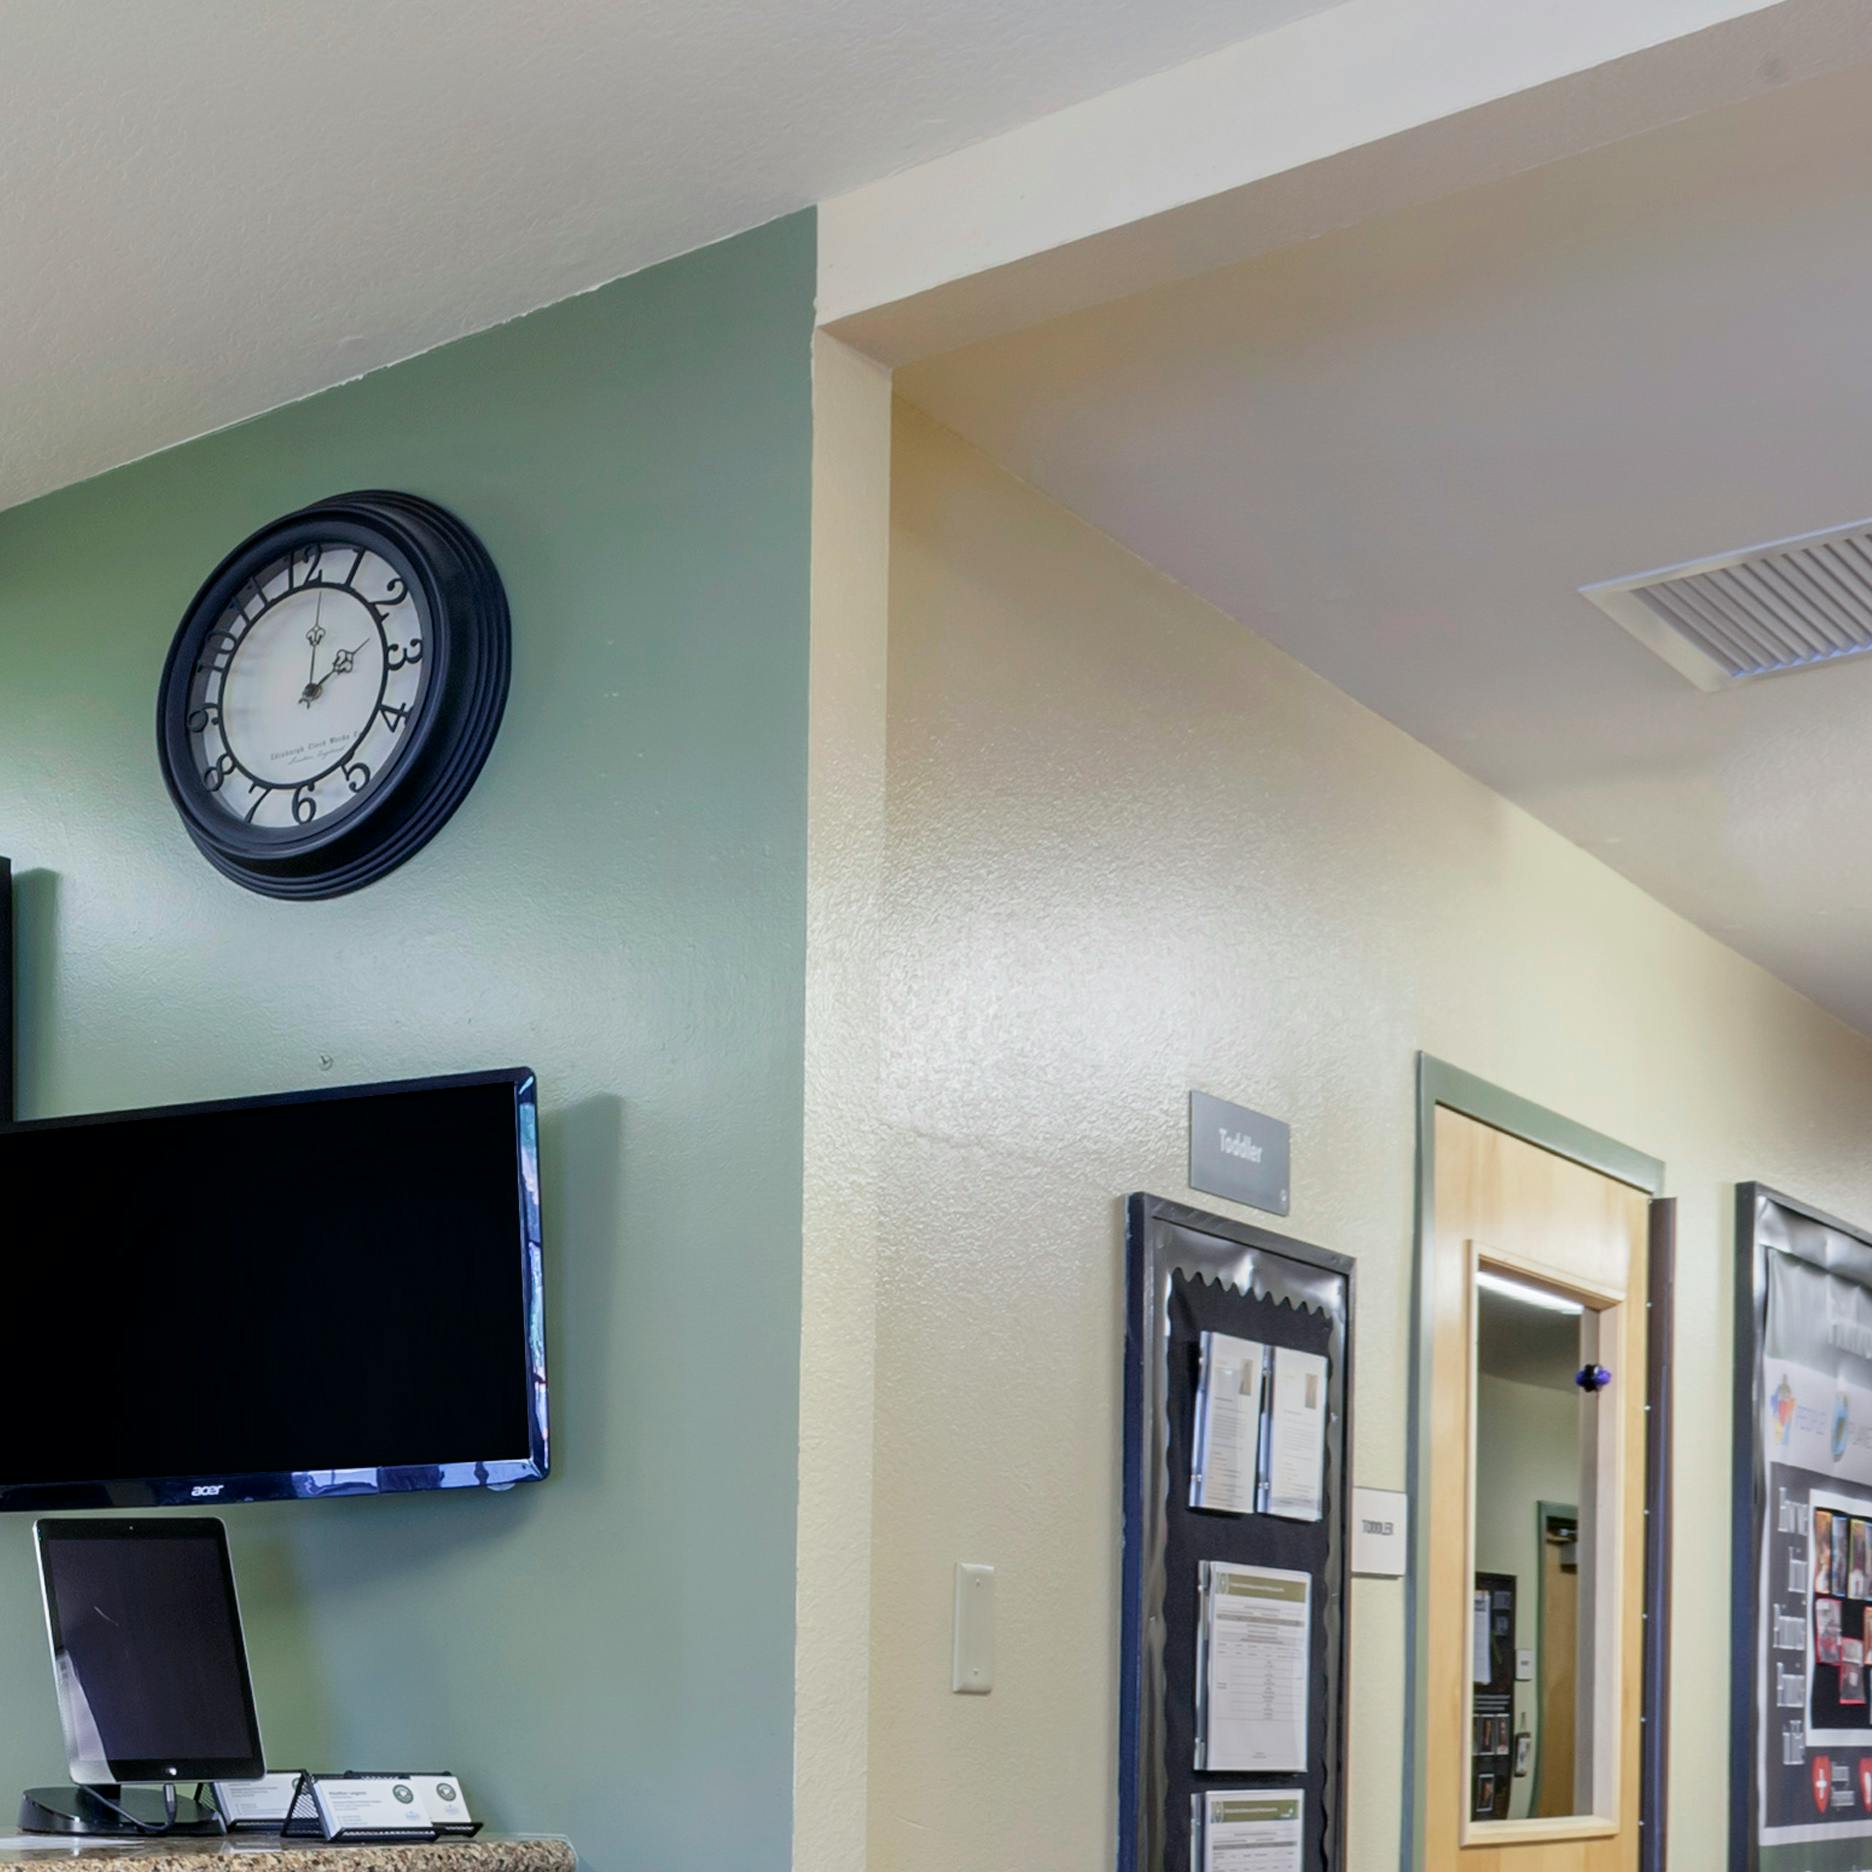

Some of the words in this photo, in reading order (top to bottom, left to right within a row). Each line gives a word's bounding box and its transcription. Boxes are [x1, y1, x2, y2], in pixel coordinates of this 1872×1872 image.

[287, 541, 326, 590] 12
[370, 577, 408, 624] 2
[197, 628, 237, 674] 10
[387, 636, 424, 672] 3
[188, 701, 221, 734] 9
[380, 700, 415, 734] 4
[307, 740, 327, 750] Clock
[329, 733, 351, 744] Works
[203, 754, 236, 793] 8
[341, 755, 372, 795] 5
[244, 783, 272, 825] 7
[291, 783, 318, 826] 6
[1218, 1127, 1264, 1164] Toddler
[190, 1484, 225, 1497] acer
[1361, 1518, 1394, 1537] TODDLER
